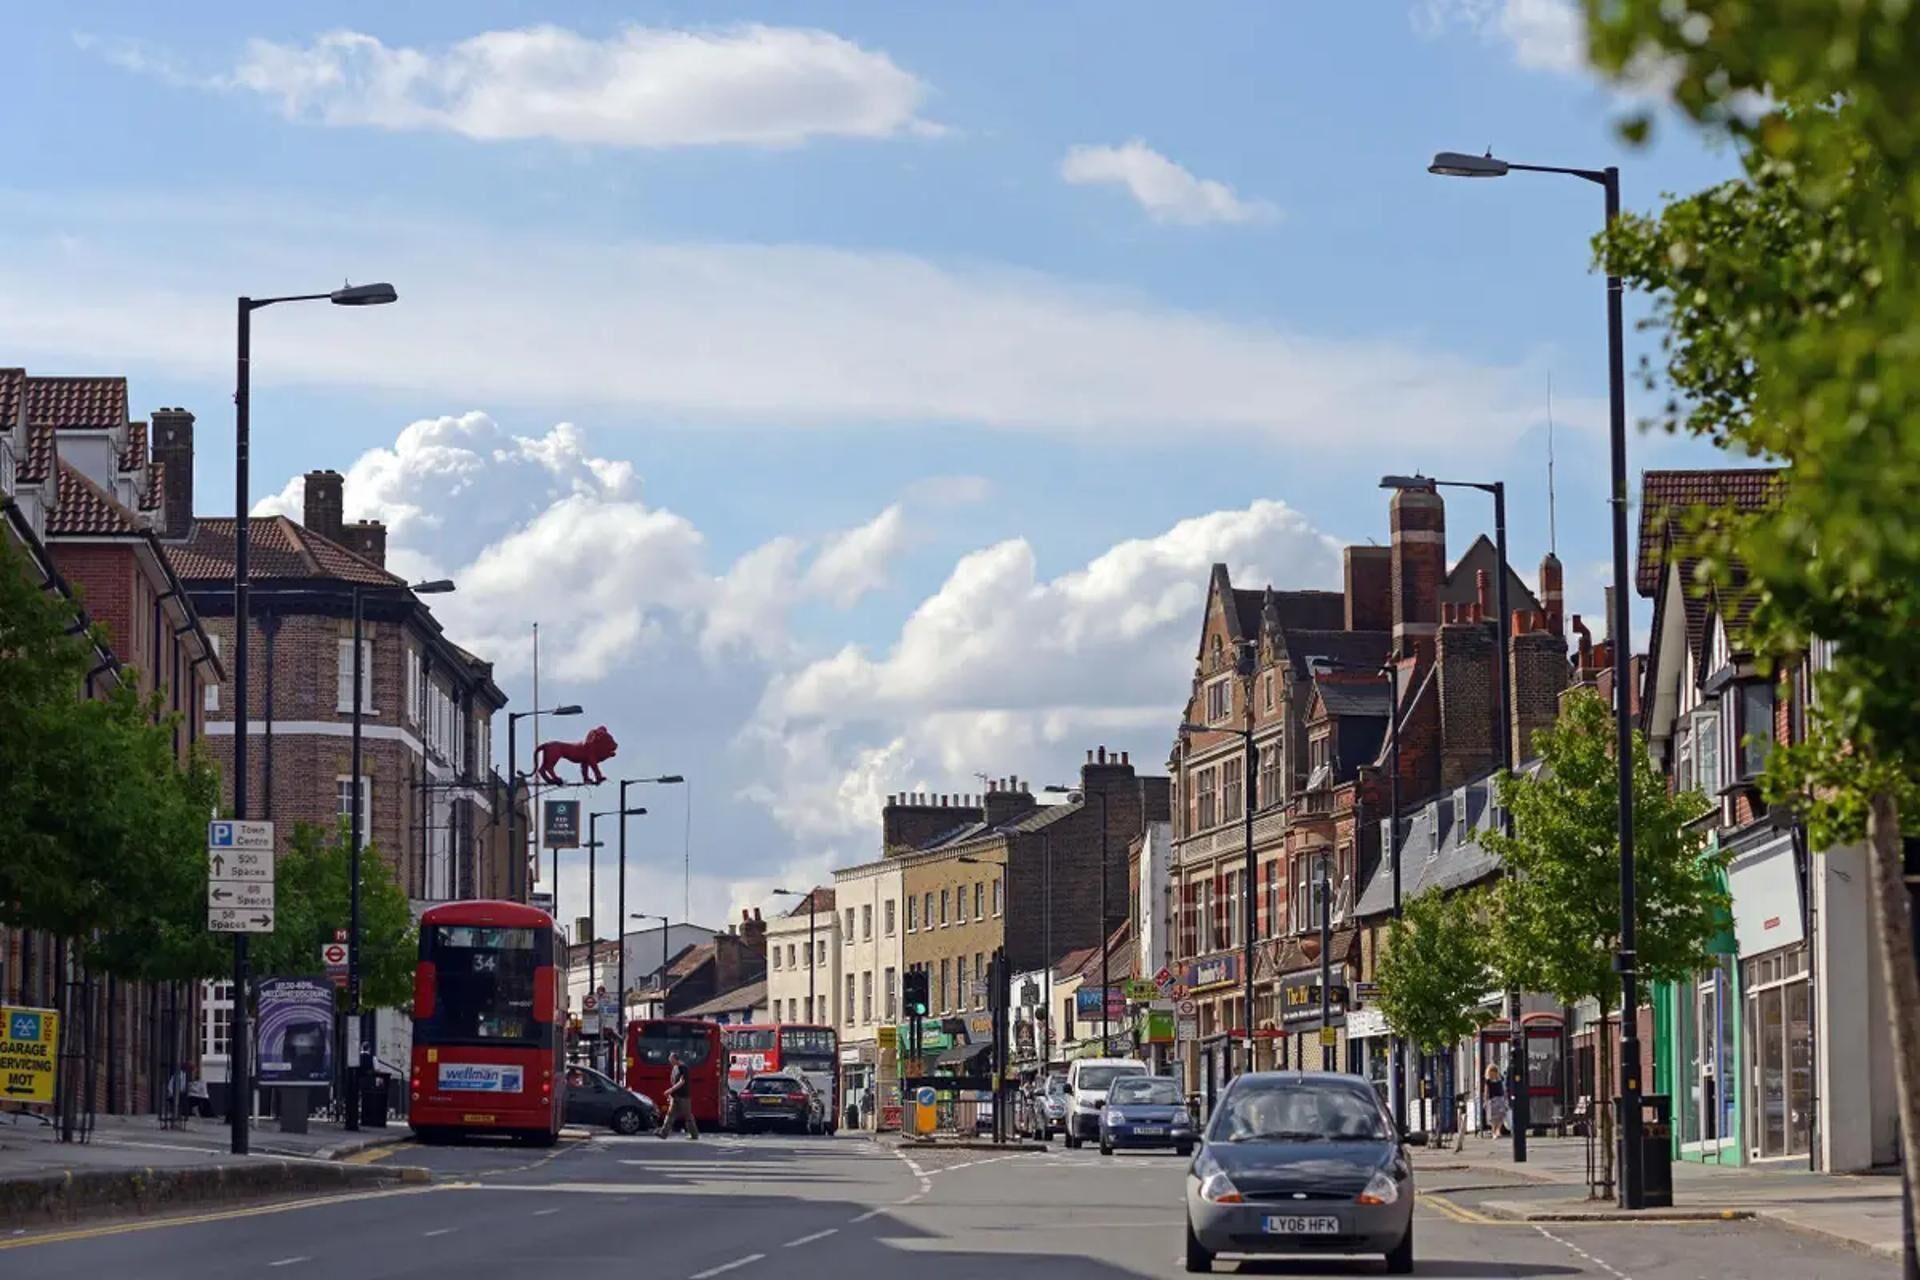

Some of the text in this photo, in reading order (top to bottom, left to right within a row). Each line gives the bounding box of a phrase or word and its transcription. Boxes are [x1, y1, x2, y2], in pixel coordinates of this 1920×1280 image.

[214, 825, 229, 844] P
[241, 825, 265, 834] Town
[237, 837, 269, 846] Centre
[238, 854, 258, 864] 520
[232, 867, 265, 877] Spaces
[237, 895, 271, 905] Spaces
[211, 920, 246, 930] Spaces
[336, 930, 347, 940] M
[473, 954, 496, 972] 34
[0, 1041, 48, 1056] GARAGE
[0, 1057, 52, 1072] ERVICING
[446, 1067, 499, 1080] wellman
[8, 1073, 34, 1086] MOT
[1270, 1218, 1336, 1231] LY06 HFK
